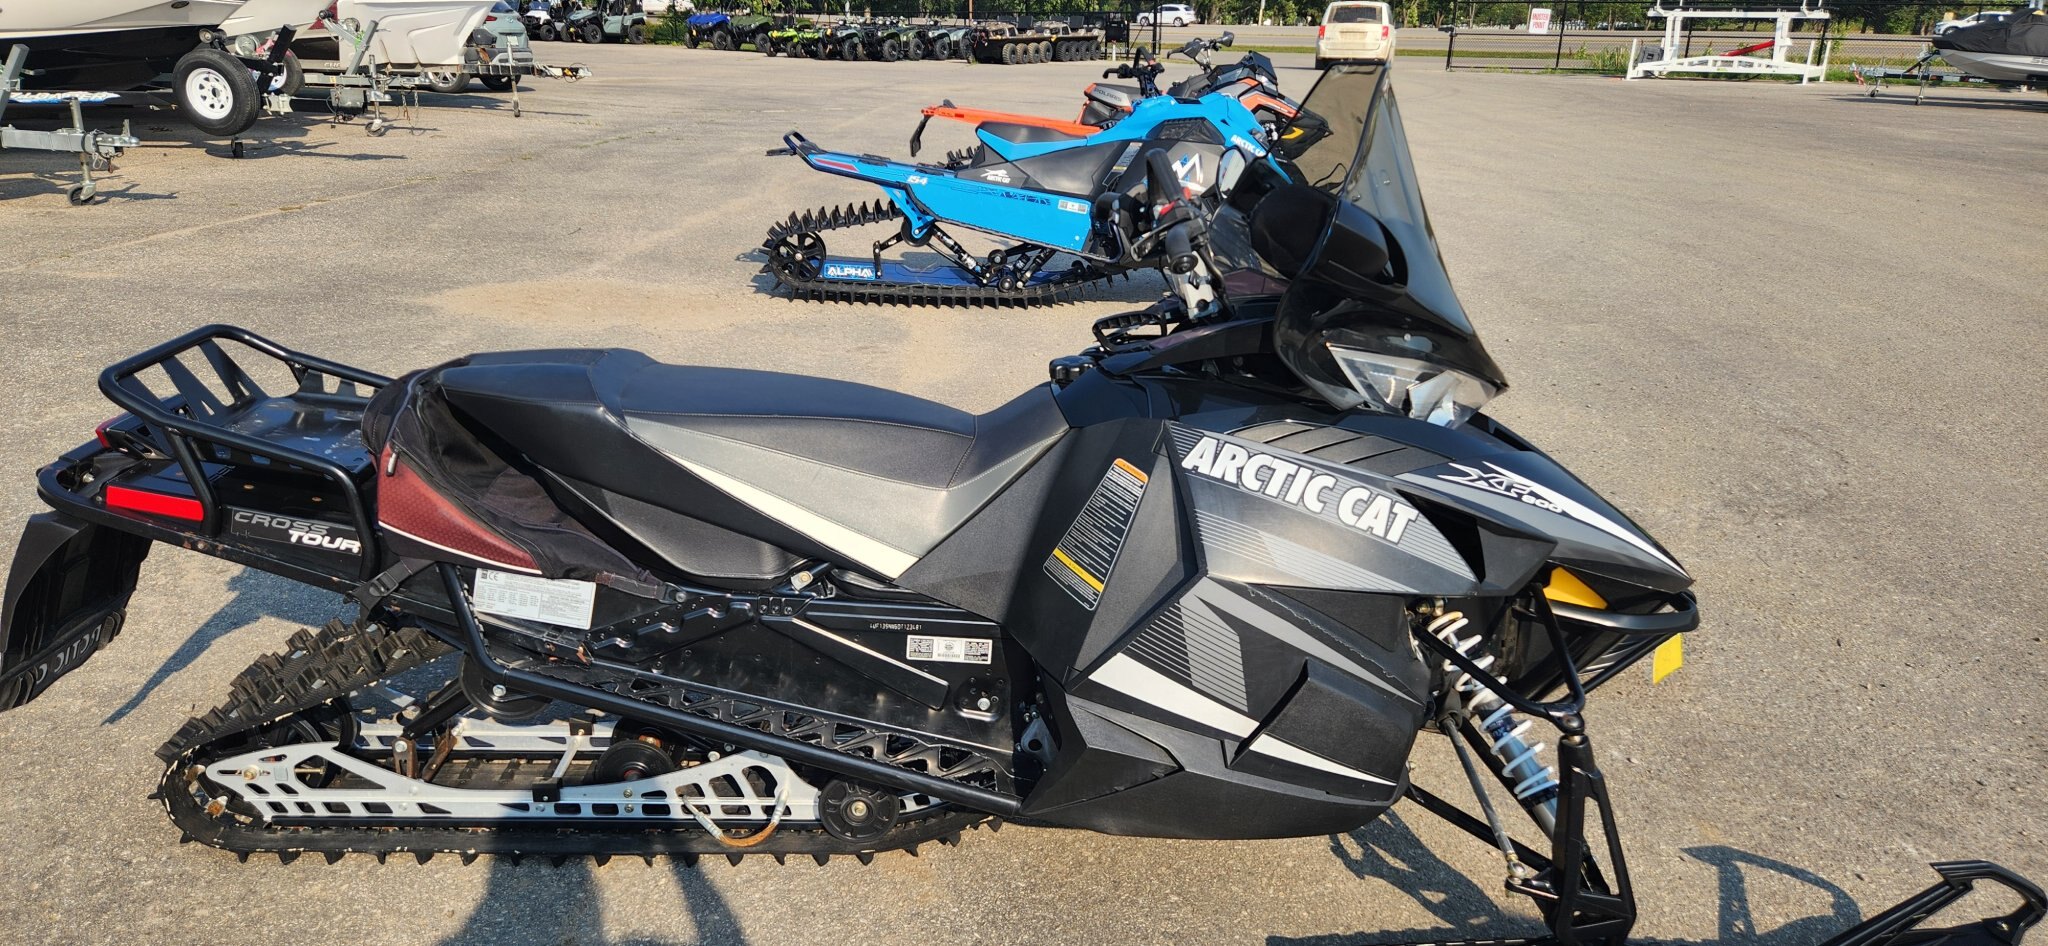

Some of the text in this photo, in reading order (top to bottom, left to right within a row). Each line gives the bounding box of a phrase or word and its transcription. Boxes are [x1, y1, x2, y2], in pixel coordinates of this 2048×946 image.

[1230, 134, 1255, 154] ARCTIC
[828, 266, 874, 278] ALPHA
[1181, 436, 1420, 545] ARCTIC CAT
[1521, 494, 1564, 514] 800
[235, 511, 331, 537] CROSS
[288, 529, 361, 554] TOUR
